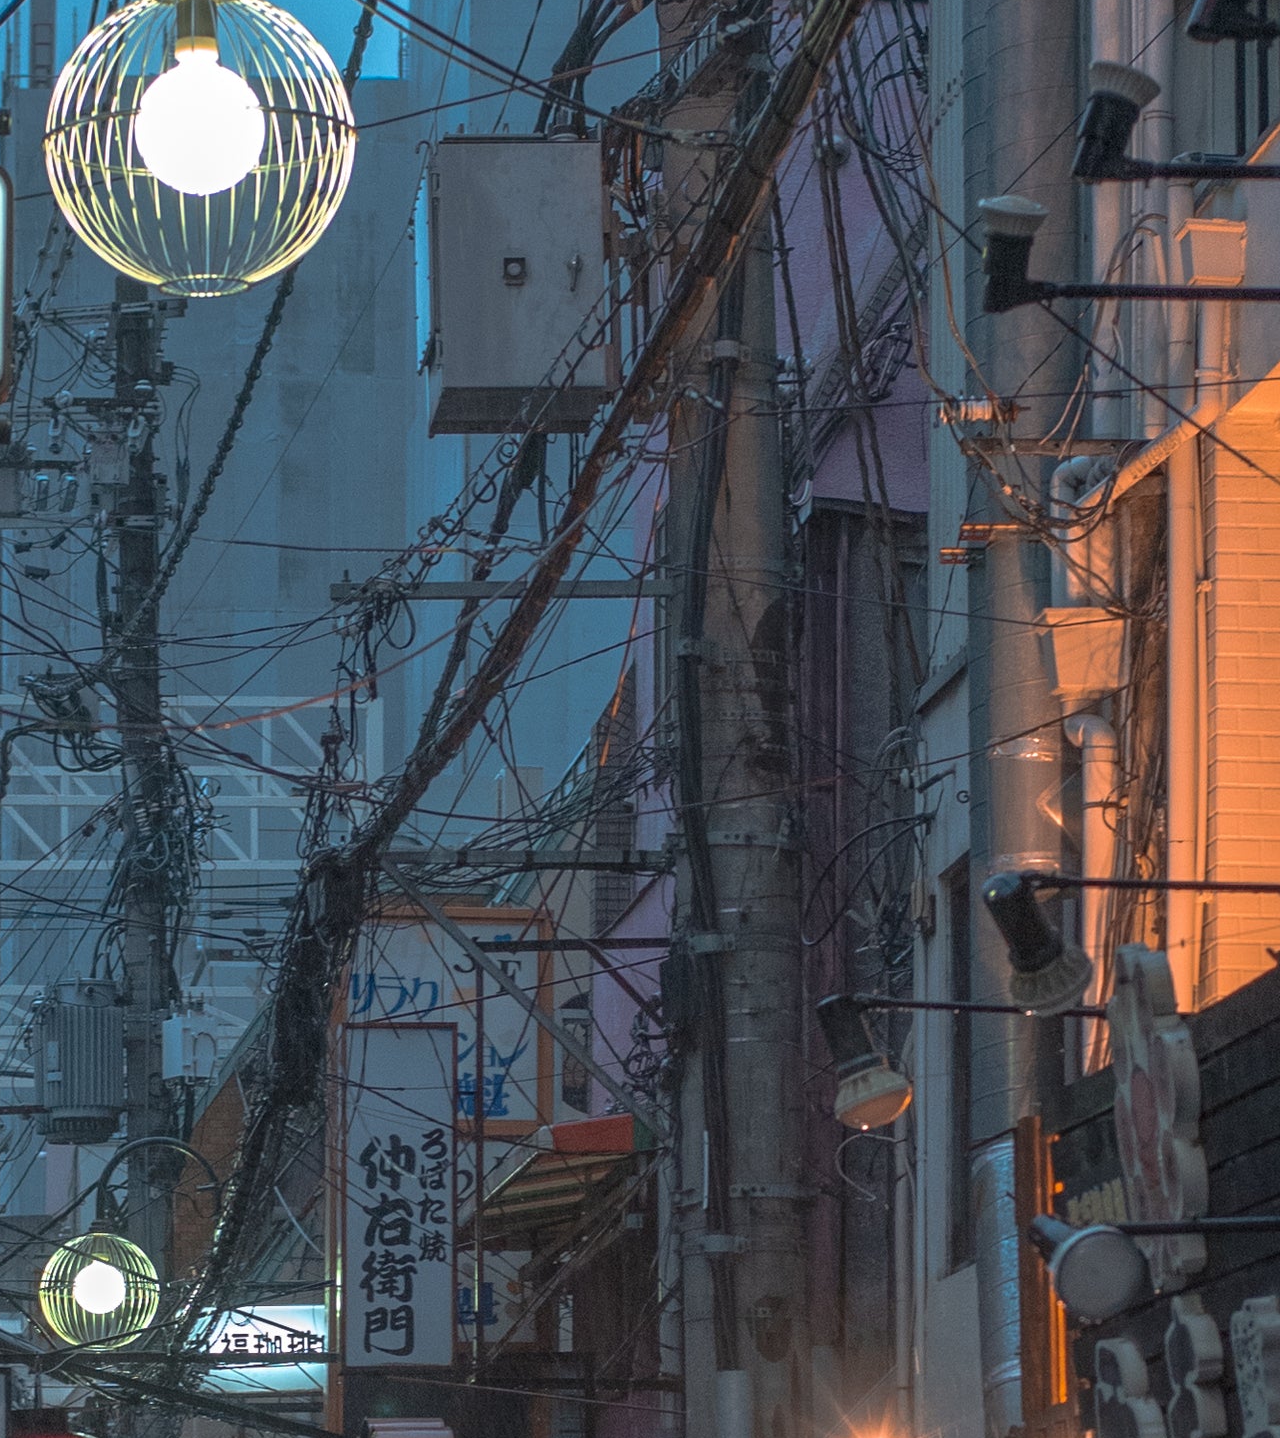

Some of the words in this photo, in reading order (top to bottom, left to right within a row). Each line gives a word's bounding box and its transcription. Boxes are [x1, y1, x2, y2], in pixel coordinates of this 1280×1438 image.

[358, 1133, 419, 1357] 仲右衛門
[418, 1127, 448, 1263] ろばた焼
